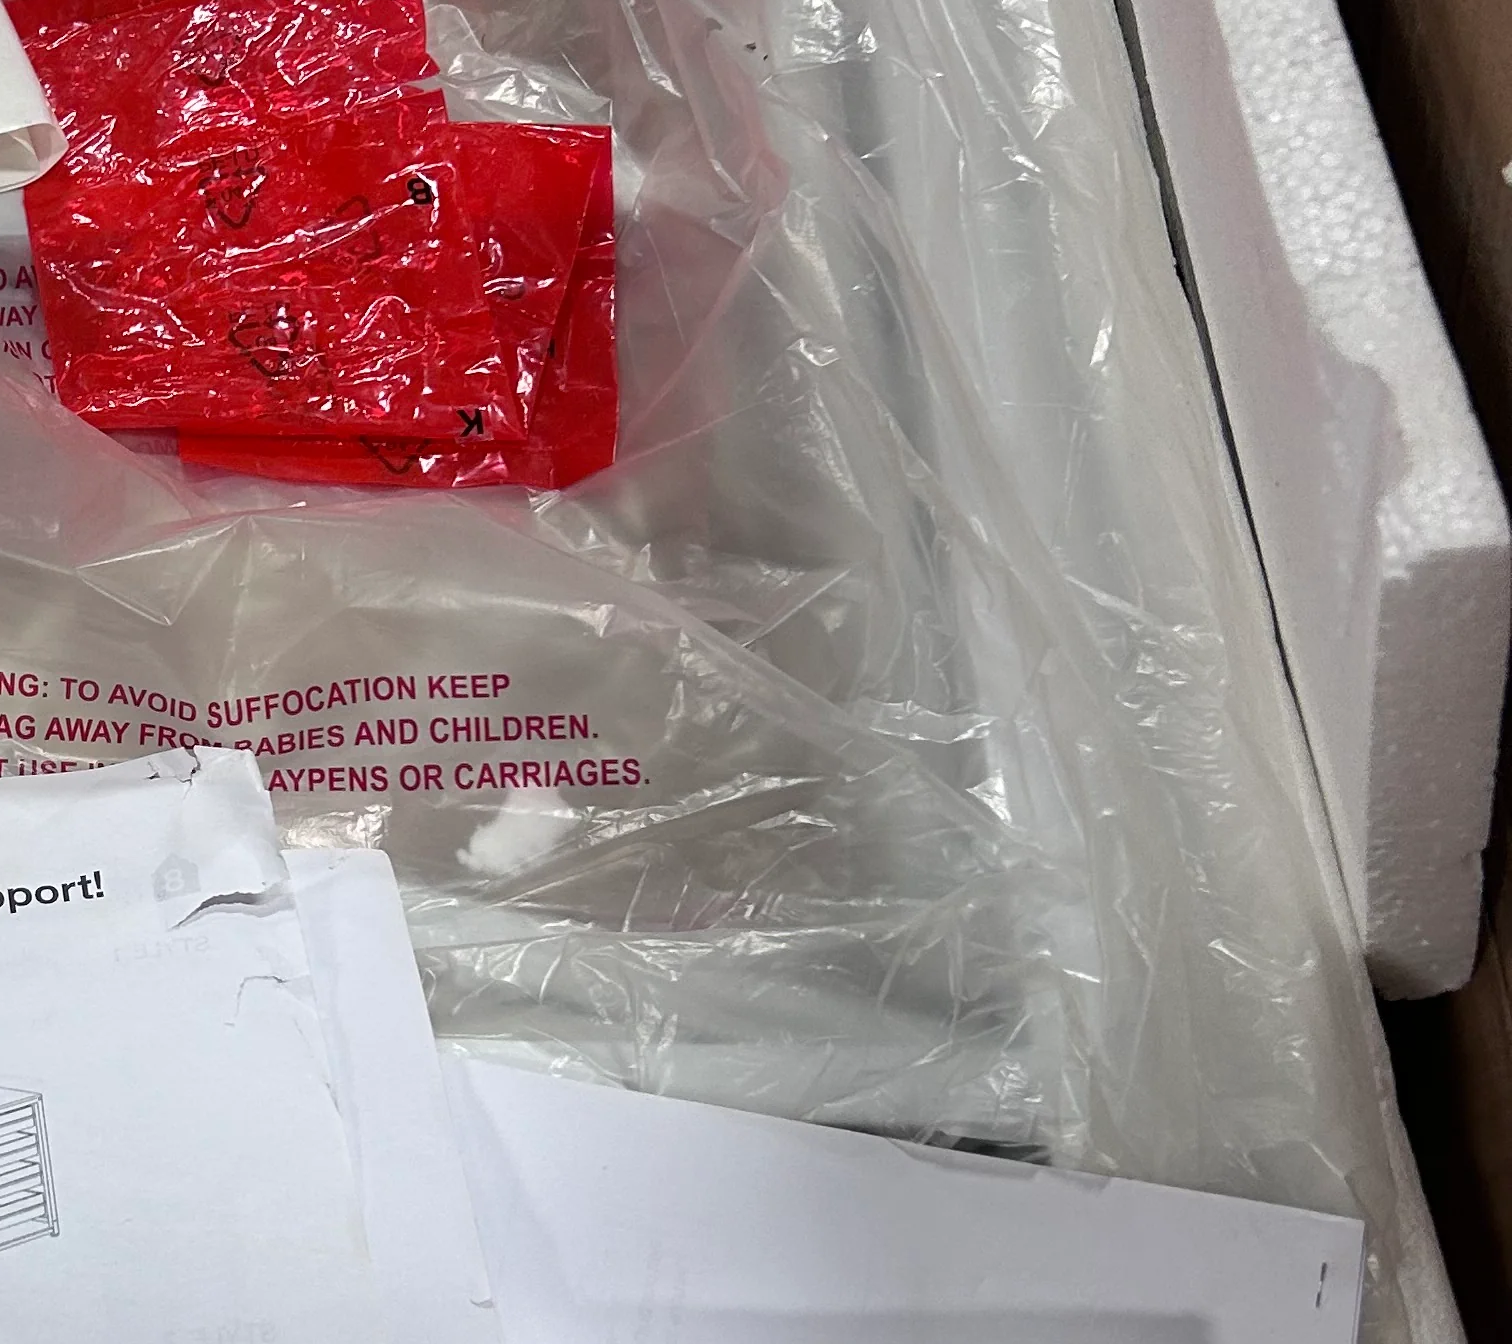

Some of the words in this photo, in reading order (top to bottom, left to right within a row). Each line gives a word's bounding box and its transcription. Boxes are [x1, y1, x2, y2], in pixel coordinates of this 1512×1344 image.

[60, 676, 100, 702] TO
[108, 683, 197, 722] AVOID
[207, 674, 417, 729] SUFFOCATION
[428, 673, 511, 700] KEEP
[44, 717, 131, 744] AWAY
[354, 718, 419, 746] AND
[429, 713, 599, 743] CHILDREN.
[268, 764, 389, 792] AYPENS
[398, 763, 445, 792] OR
[453, 757, 651, 791] CARRIAGES.
